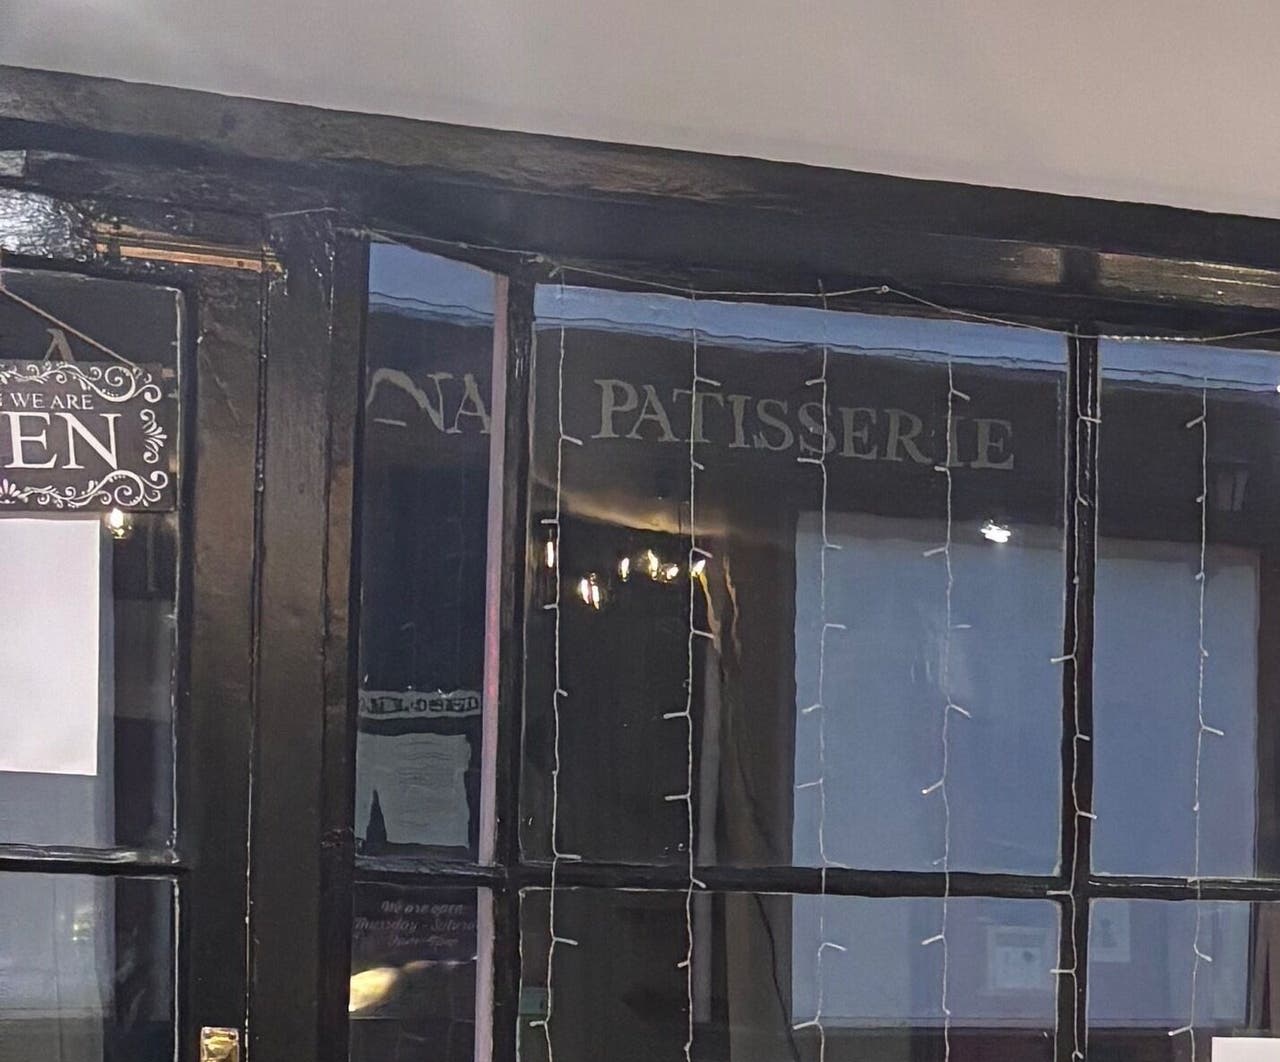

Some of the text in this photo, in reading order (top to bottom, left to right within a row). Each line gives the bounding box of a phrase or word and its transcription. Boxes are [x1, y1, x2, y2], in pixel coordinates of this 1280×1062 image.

[10, 393, 45, 408] WE
[50, 394, 94, 410] ARE
[591, 378, 1015, 470] PATISSERIE
